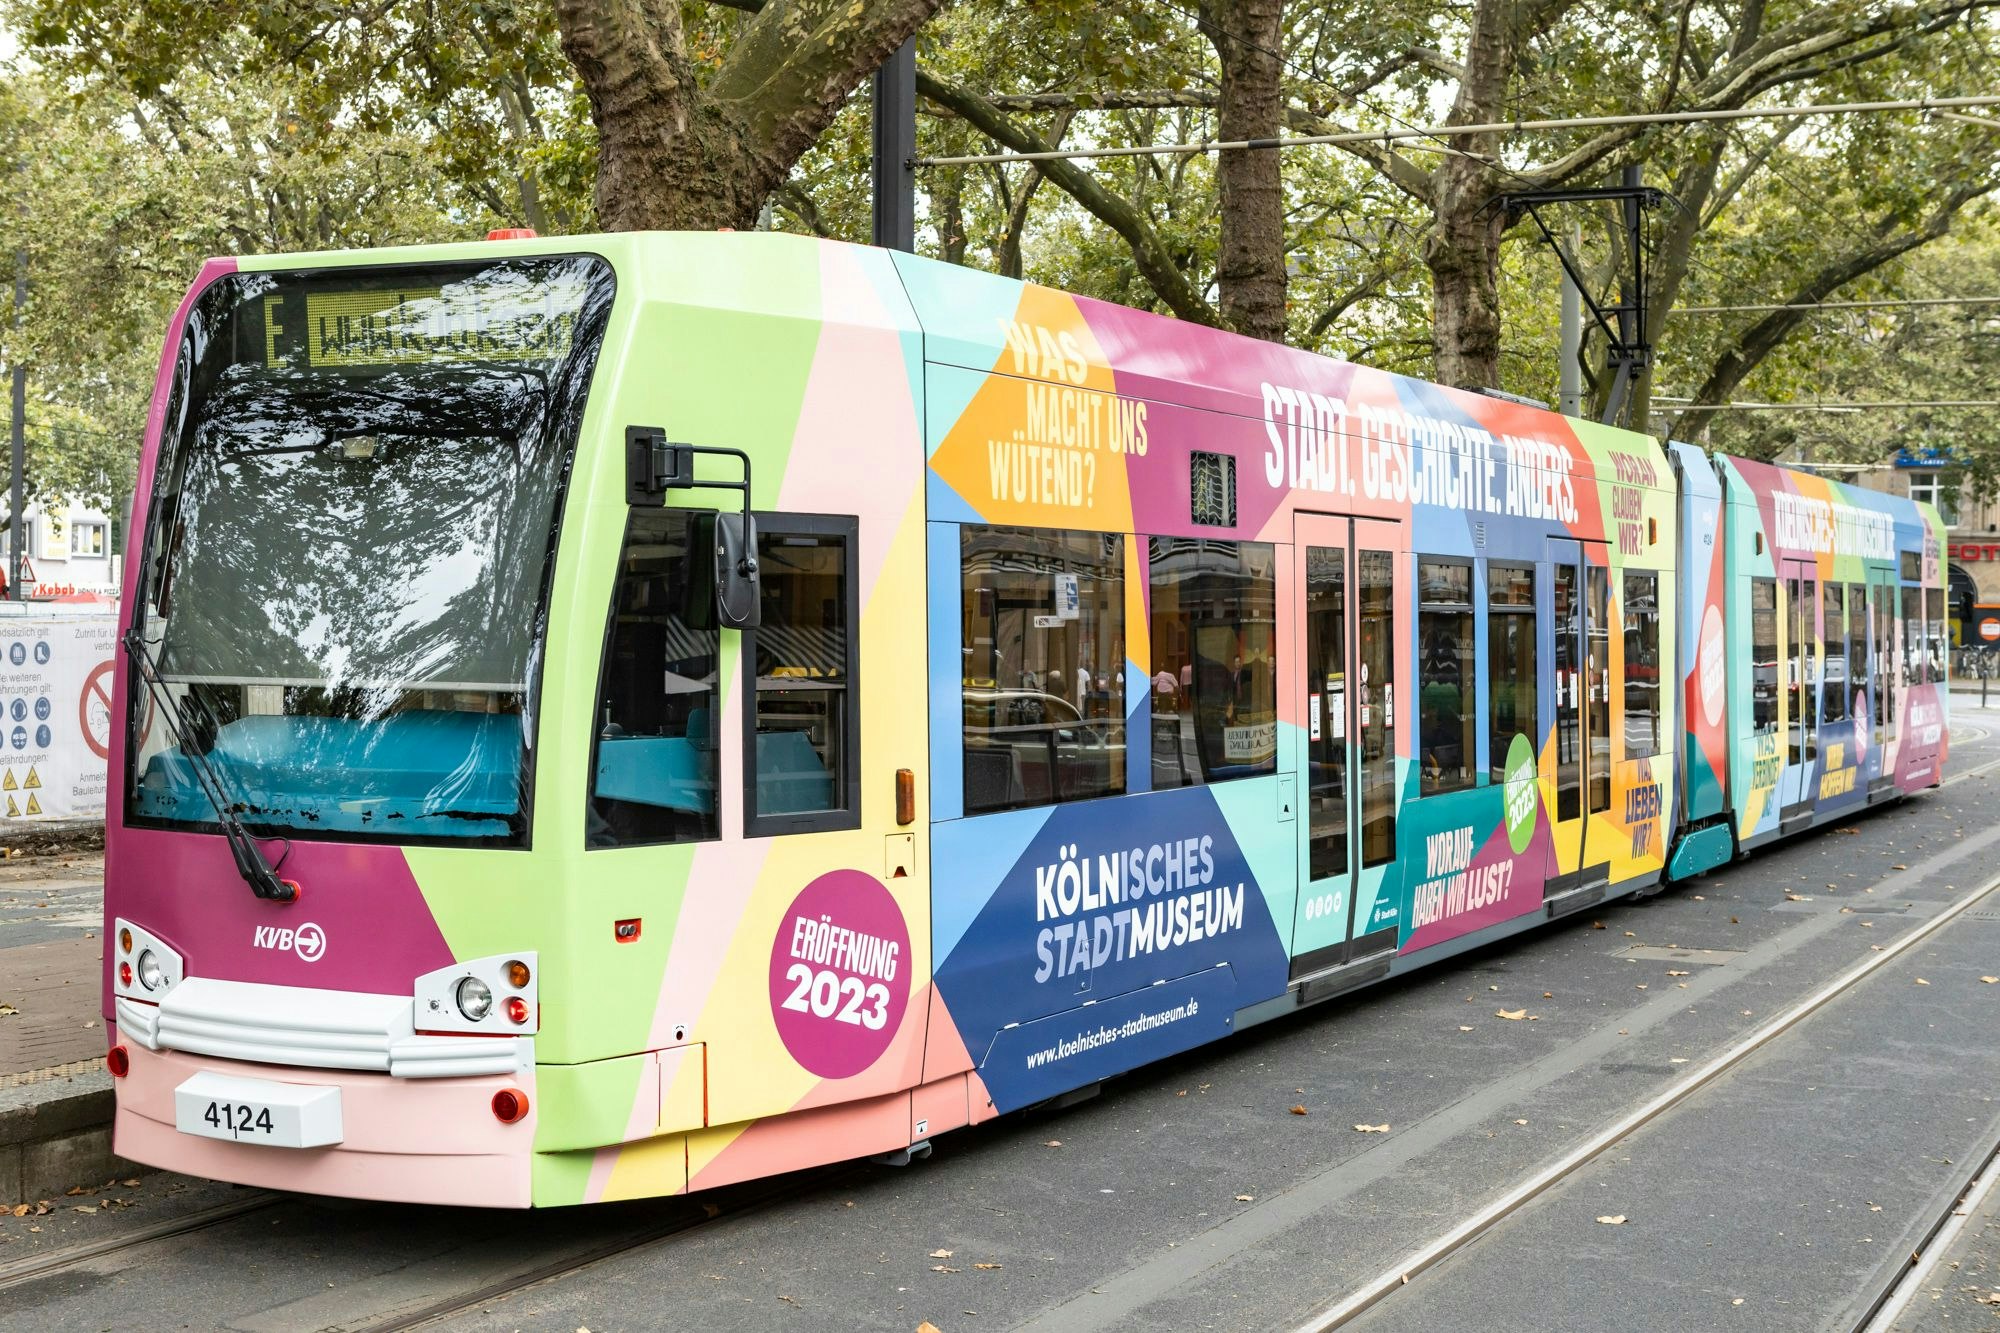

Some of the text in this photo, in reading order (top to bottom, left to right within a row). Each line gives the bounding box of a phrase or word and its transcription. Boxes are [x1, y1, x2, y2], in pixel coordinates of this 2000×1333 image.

[996, 317, 1088, 385] WAS
[1026, 382, 1148, 457] MACHT UNS
[987, 429, 1096, 509] WÜTEND?
[1260, 381, 1579, 525] STADT. GESCHICHTE. ANDERS.
[1607, 450, 1658, 488] WORAN
[1612, 485, 1643, 521] GLAUBEN
[1618, 521, 1644, 556] WIR?
[39, 583, 75, 595] Kebab
[75, 628, 96, 639] Zutritt
[97, 627, 108, 638] für
[94, 641, 114, 651] verbo
[80, 772, 106, 783] Anmeld
[1509, 783, 1535, 835] 2023
[1625, 783, 1663, 825] LIEBEN
[1426, 825, 1474, 880] WORAUF
[1631, 821, 1652, 860] WIR?
[1035, 834, 1215, 922] KÖLNISCHES
[1411, 858, 1514, 930] HABEN WIR LUST?
[253, 925, 295, 951] KVB
[790, 914, 899, 982] ERÖFFNUNG
[1033, 882, 1245, 984] STADTMUSEUM
[781, 963, 891, 1031] 2023
[1026, 996, 1199, 1070] www.koelnisches-stadtmuseum.de
[204, 1101, 274, 1134] 4124
